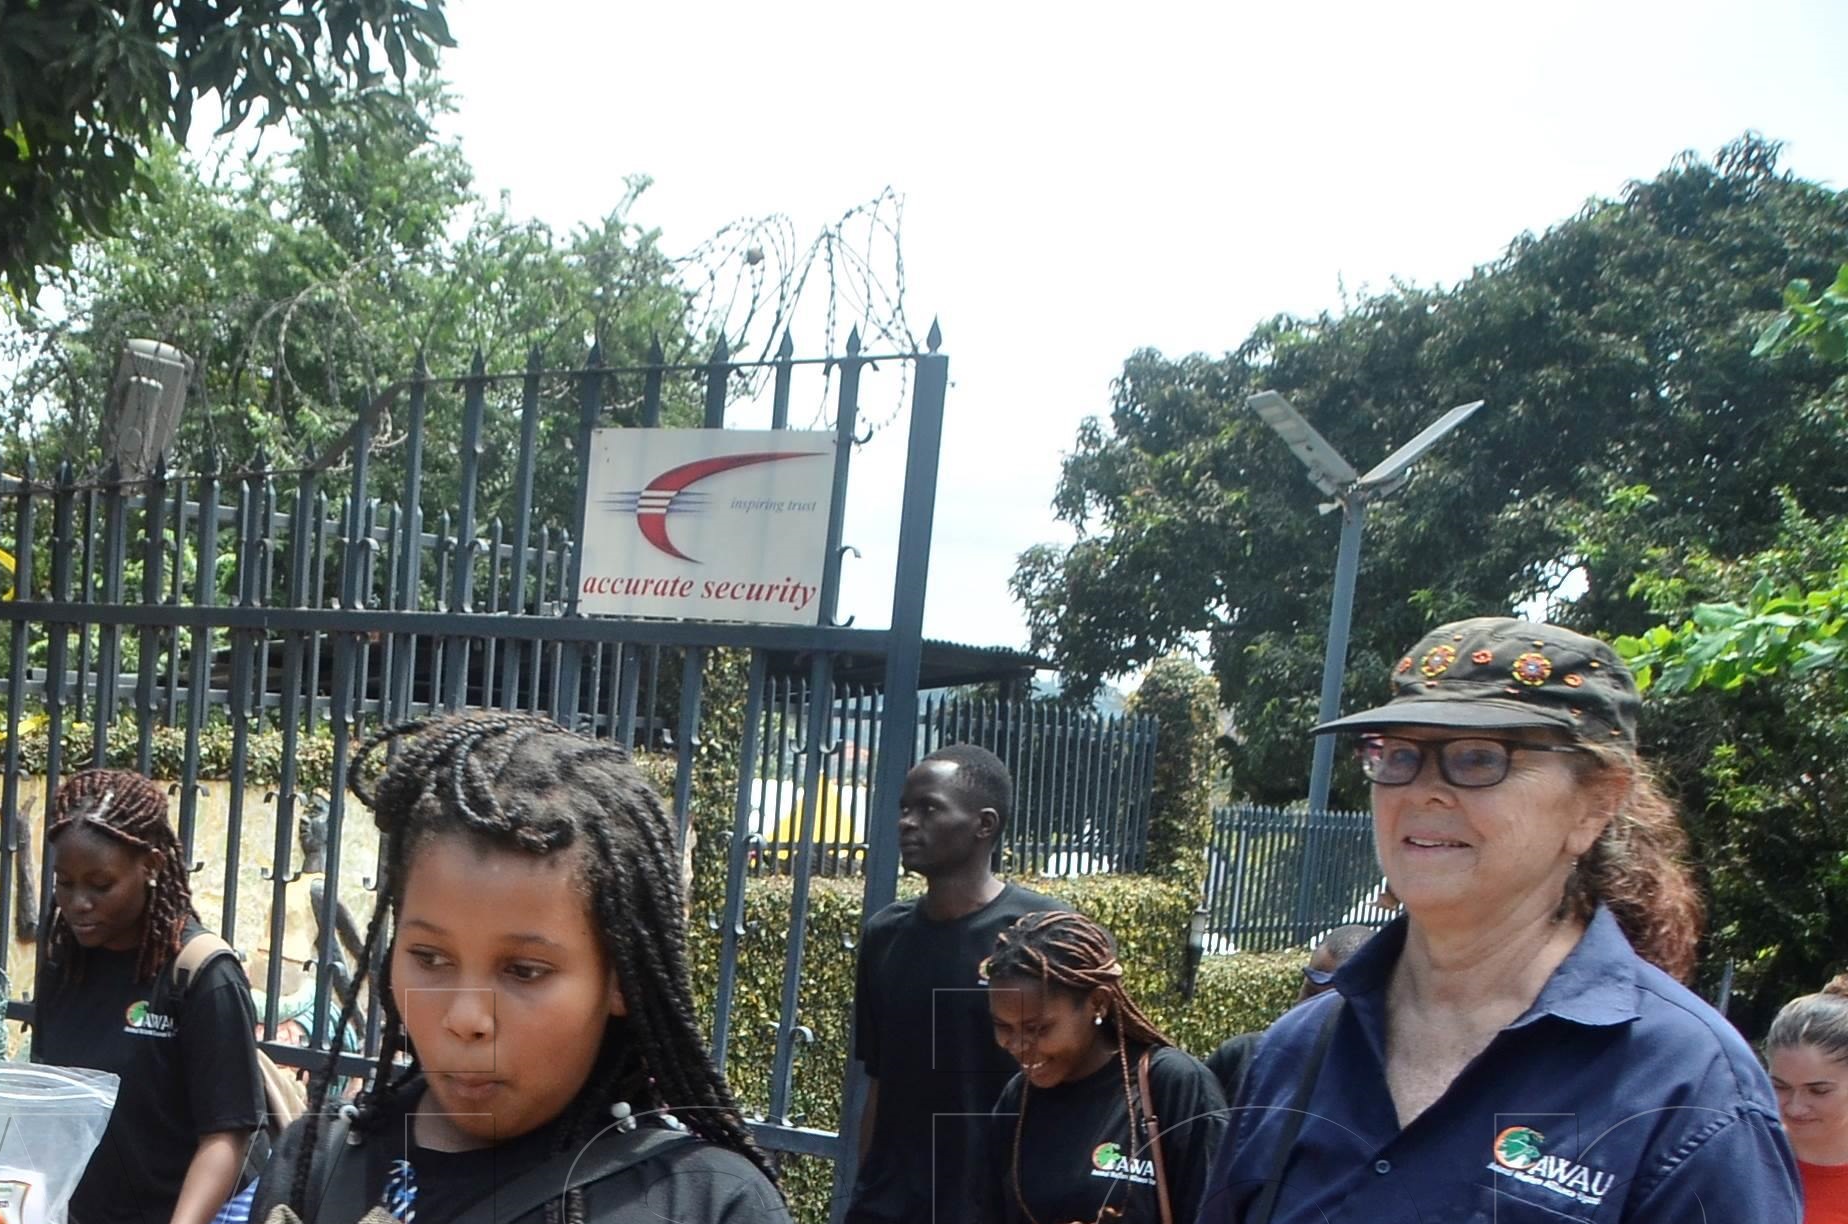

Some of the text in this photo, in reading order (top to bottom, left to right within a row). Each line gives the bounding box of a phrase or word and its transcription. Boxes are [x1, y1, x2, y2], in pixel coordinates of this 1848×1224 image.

[729, 496, 817, 513] inspiring trust
[582, 575, 817, 611] accurate security
[1527, 1154, 1615, 1197] AWAU
